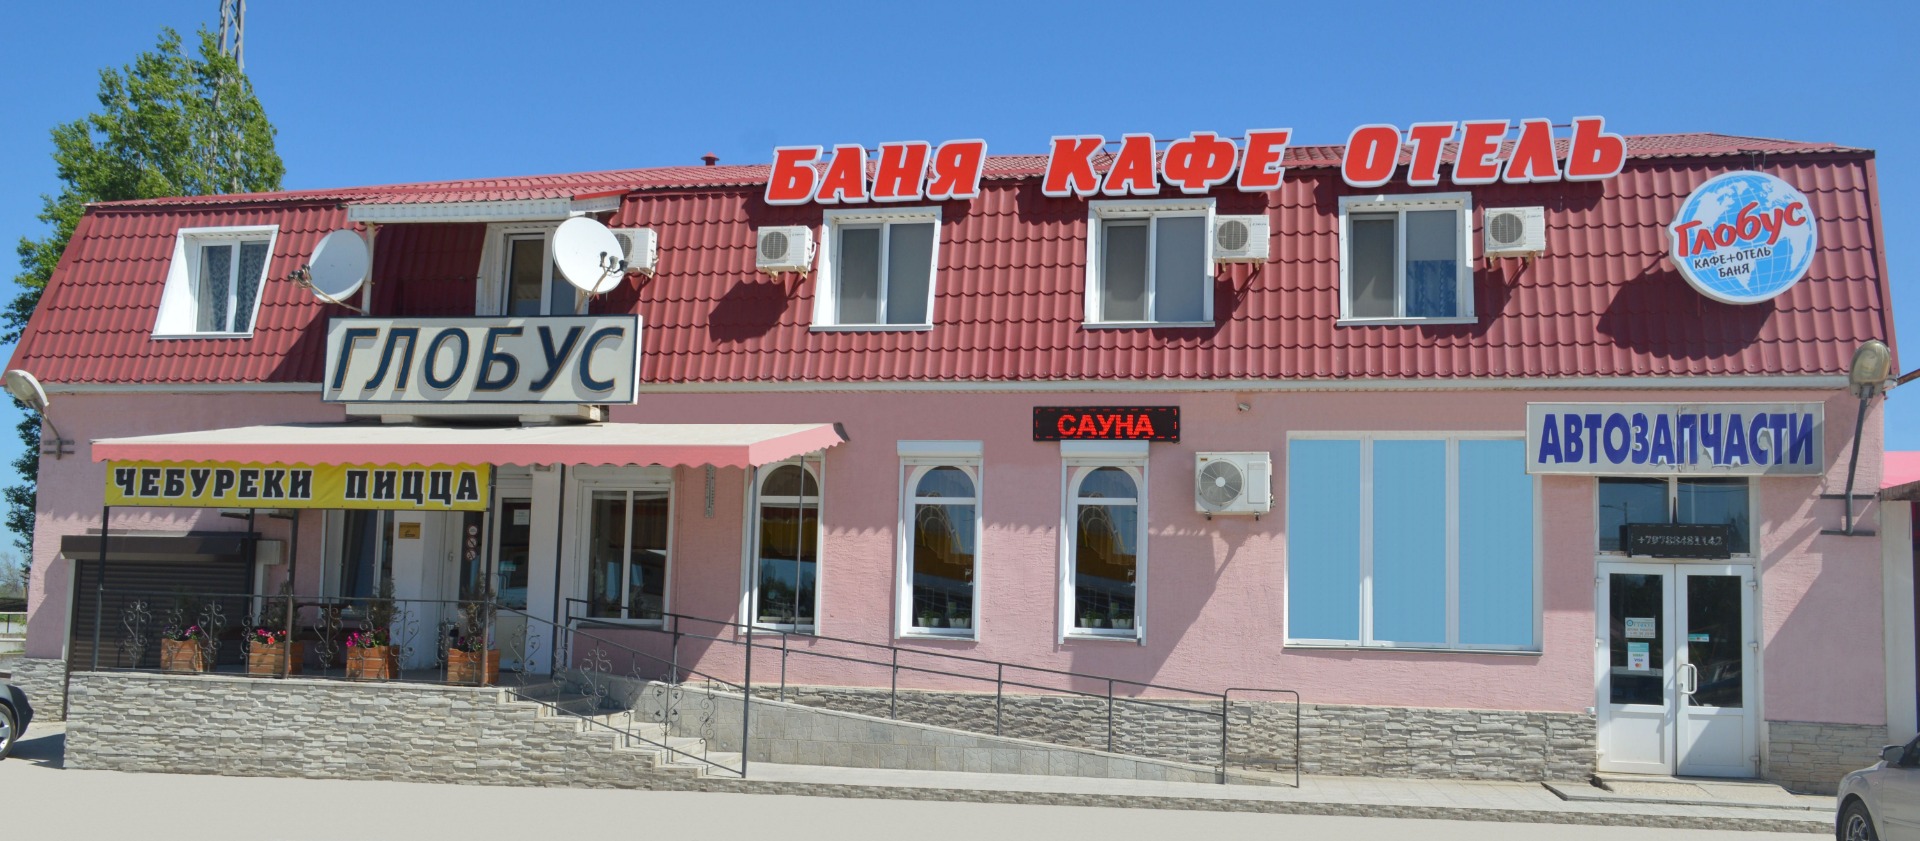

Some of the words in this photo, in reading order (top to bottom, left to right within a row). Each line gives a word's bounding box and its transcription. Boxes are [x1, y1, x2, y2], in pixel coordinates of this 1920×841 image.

[765, 139, 986, 203] БАНЯ
[1043, 129, 1291, 194] КАФЕ
[1342, 116, 1626, 186] ОТЕЛЬ
[1674, 201, 1807, 257] Глобус
[1693, 247, 1771, 269] КАФЕ+ОТЕЛЬ
[1718, 263, 1750, 278] БАНЯ
[332, 325, 625, 393] ГЛОБУС
[1057, 414, 1155, 436] САУНА
[1538, 412, 1814, 466] АВТОЗАПЧАСТИ
[115, 467, 313, 500] ЧЕБУРЕКИ
[345, 469, 480, 506] ПИЦЦА
